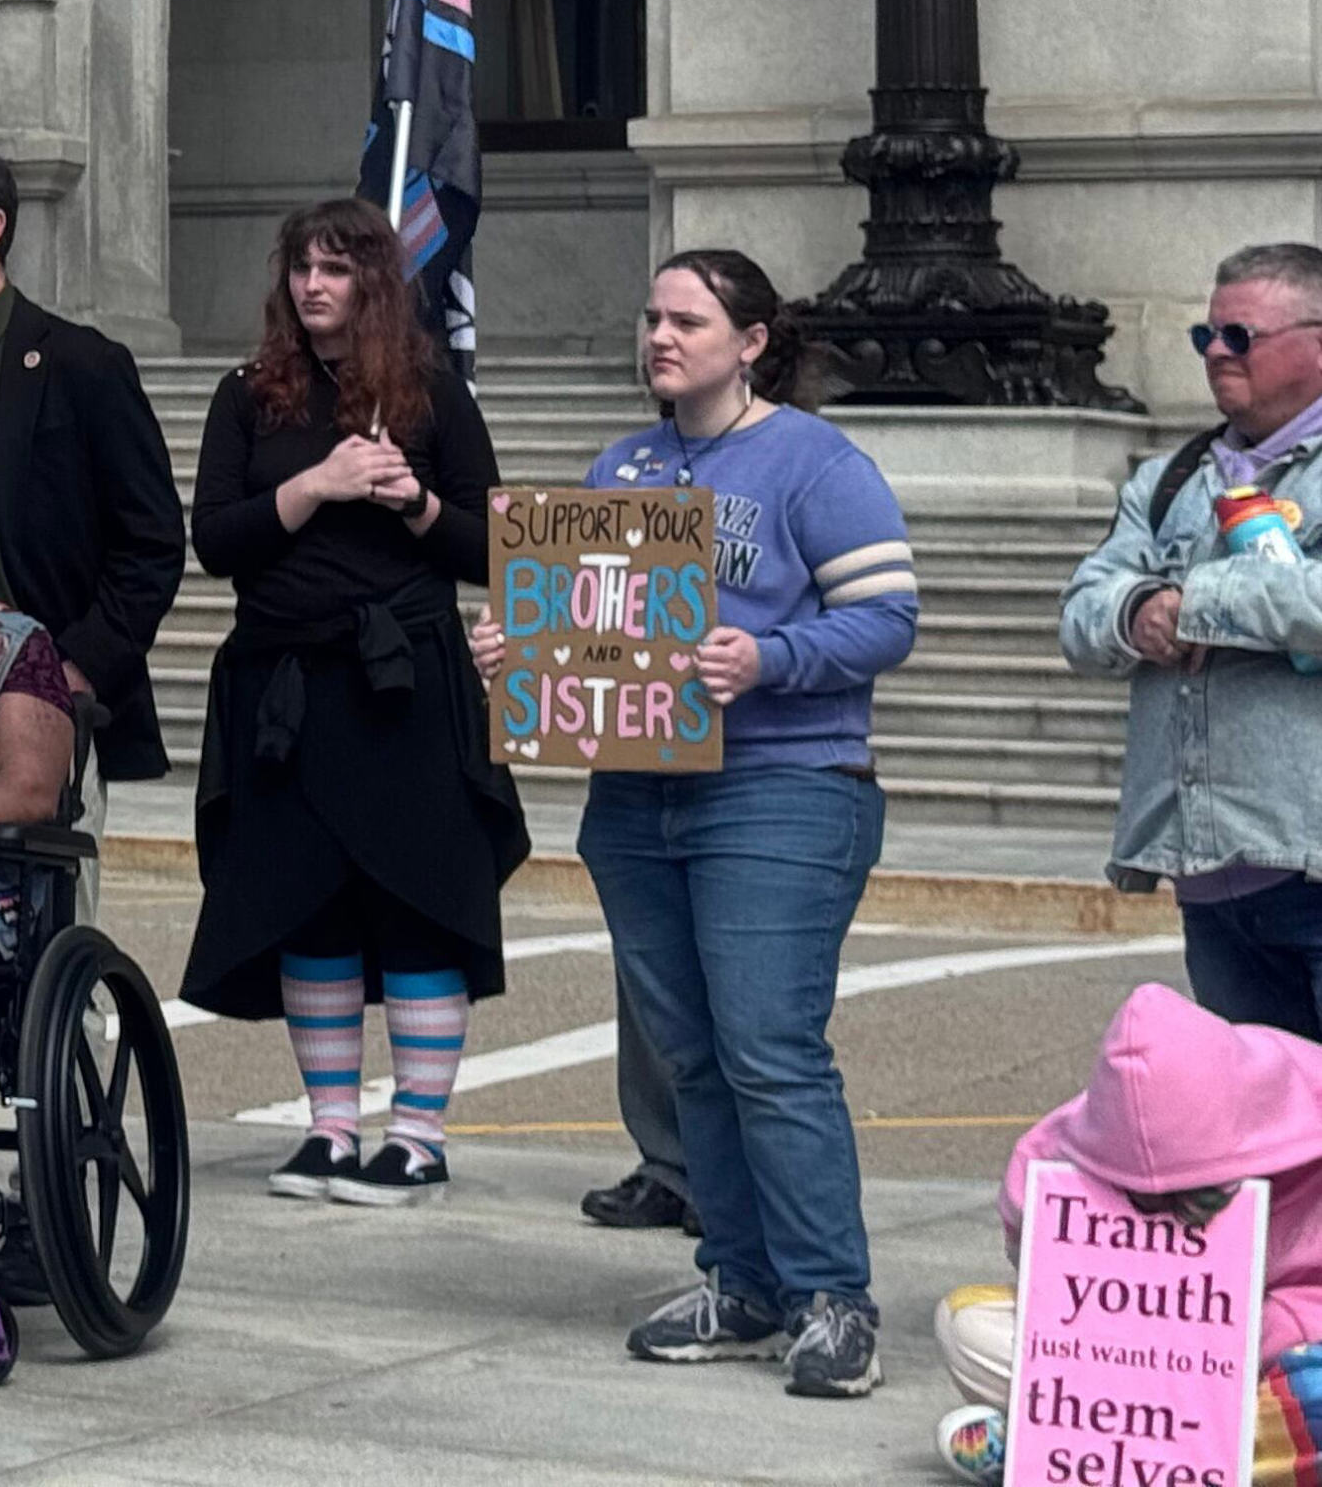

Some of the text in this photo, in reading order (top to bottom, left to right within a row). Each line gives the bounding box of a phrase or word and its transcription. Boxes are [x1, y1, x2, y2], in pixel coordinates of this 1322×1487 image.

[501, 499, 630, 550] SUPPORT
[640, 500, 703, 551] YOUR
[504, 552, 707, 645] BROTHERS
[582, 645, 622, 663] AND
[503, 669, 711, 744] SISTERS
[1045, 1193, 1208, 1257] Trans
[1060, 1272, 1235, 1326] youth
[1029, 1330, 1235, 1378] just want to be
[1027, 1376, 1201, 1443] them-
